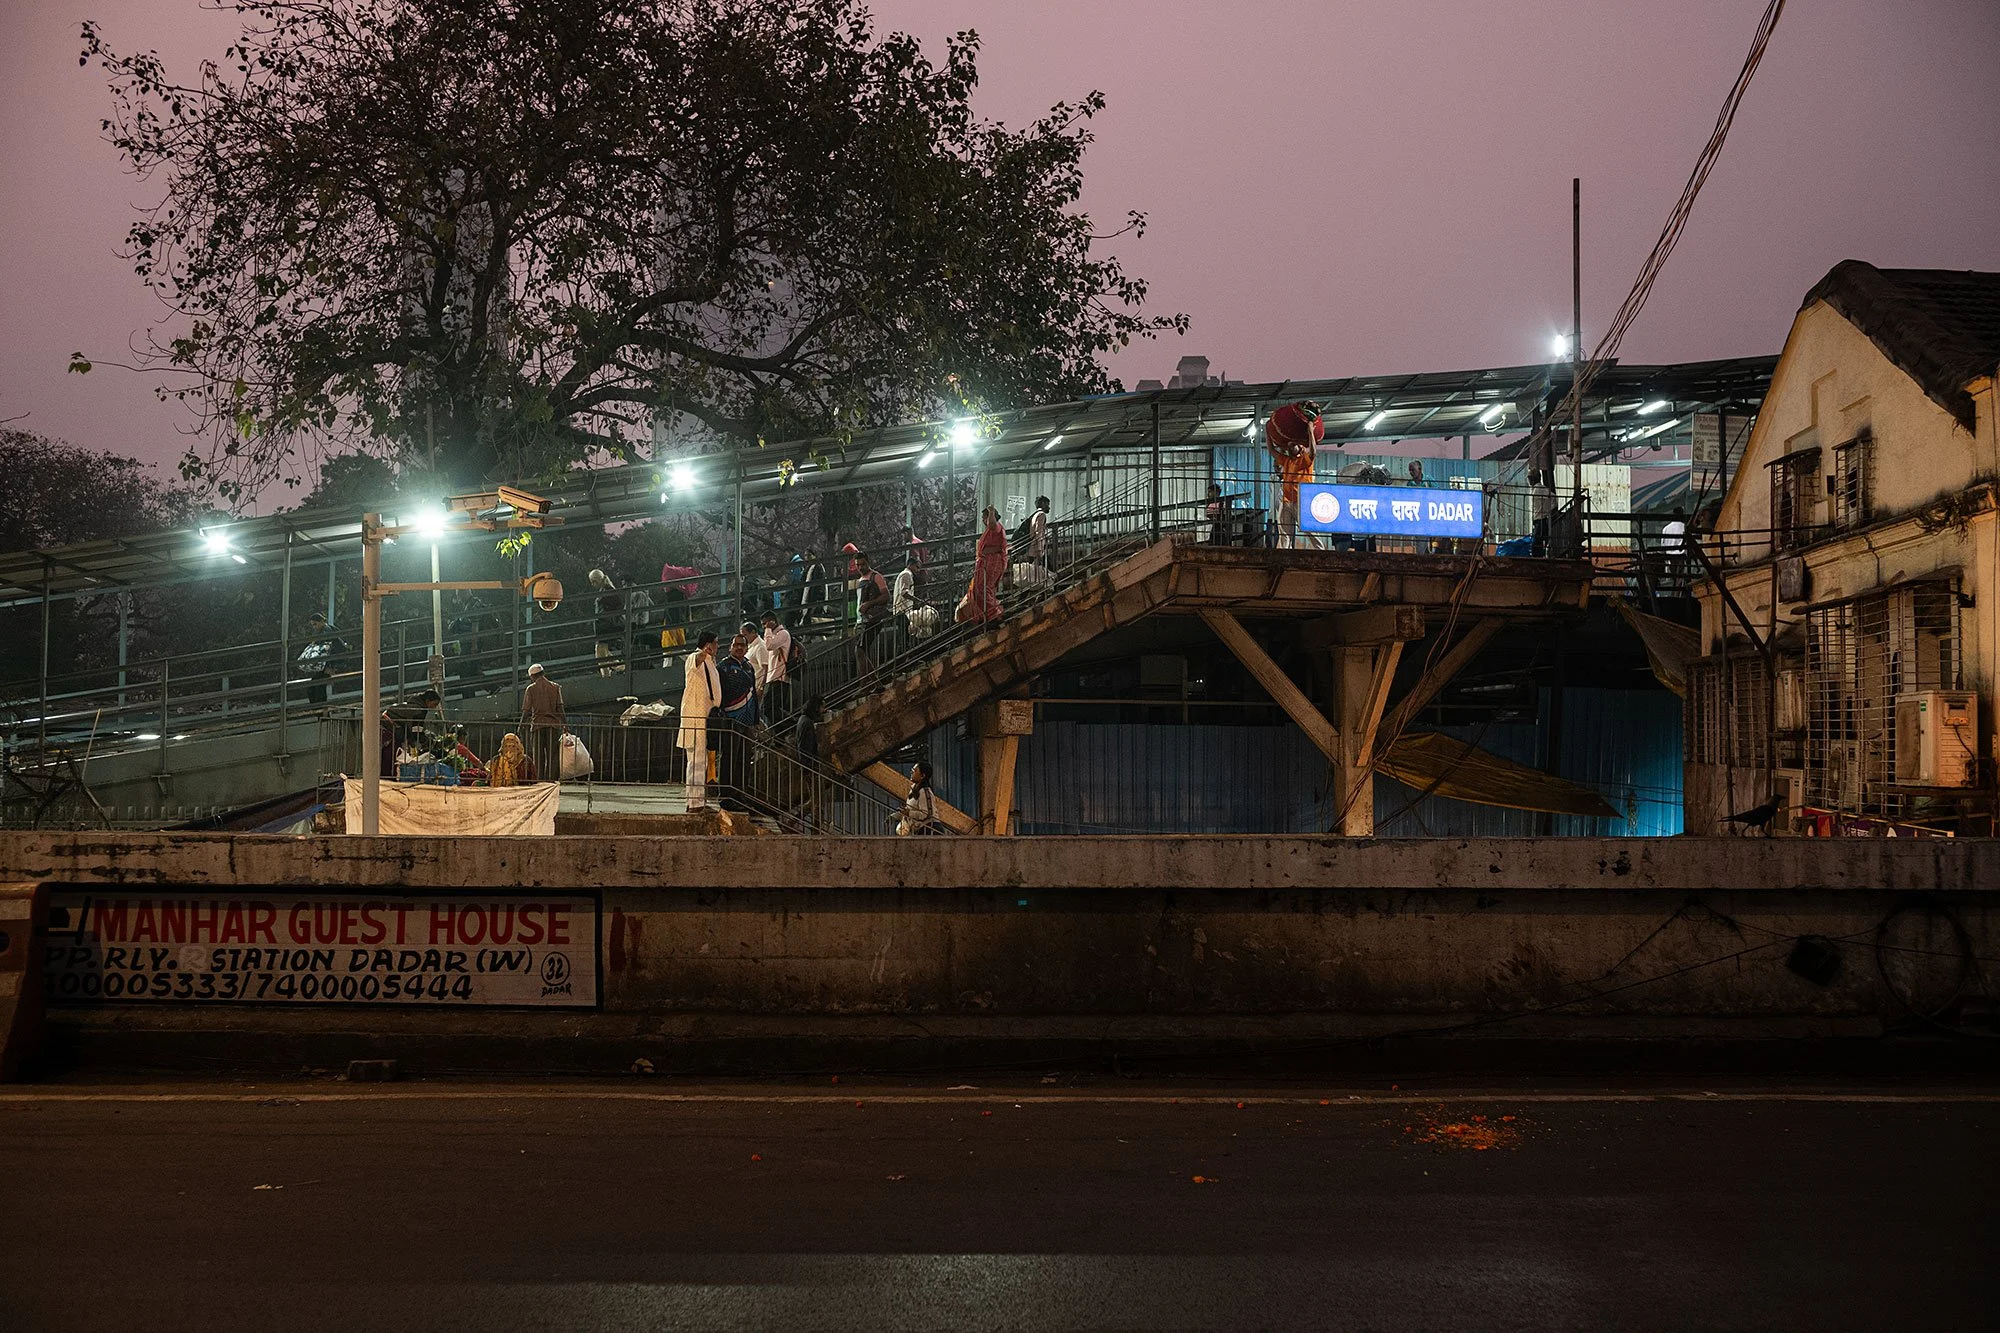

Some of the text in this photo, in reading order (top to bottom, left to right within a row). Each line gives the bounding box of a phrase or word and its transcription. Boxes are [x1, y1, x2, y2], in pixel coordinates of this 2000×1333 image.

[1348, 499, 1421, 522] दादर दादर
[1428, 502, 1474, 522] DADAR
[93, 899, 572, 945] MANHAR GUEST HOUSE
[104, 947, 178, 971] RLY.
[211, 947, 335, 972] STATION
[349, 948, 469, 973] DADAR
[476, 946, 532, 974] (W)
[546, 956, 564, 980] 32
[541, 983, 572, 997] DADAR
